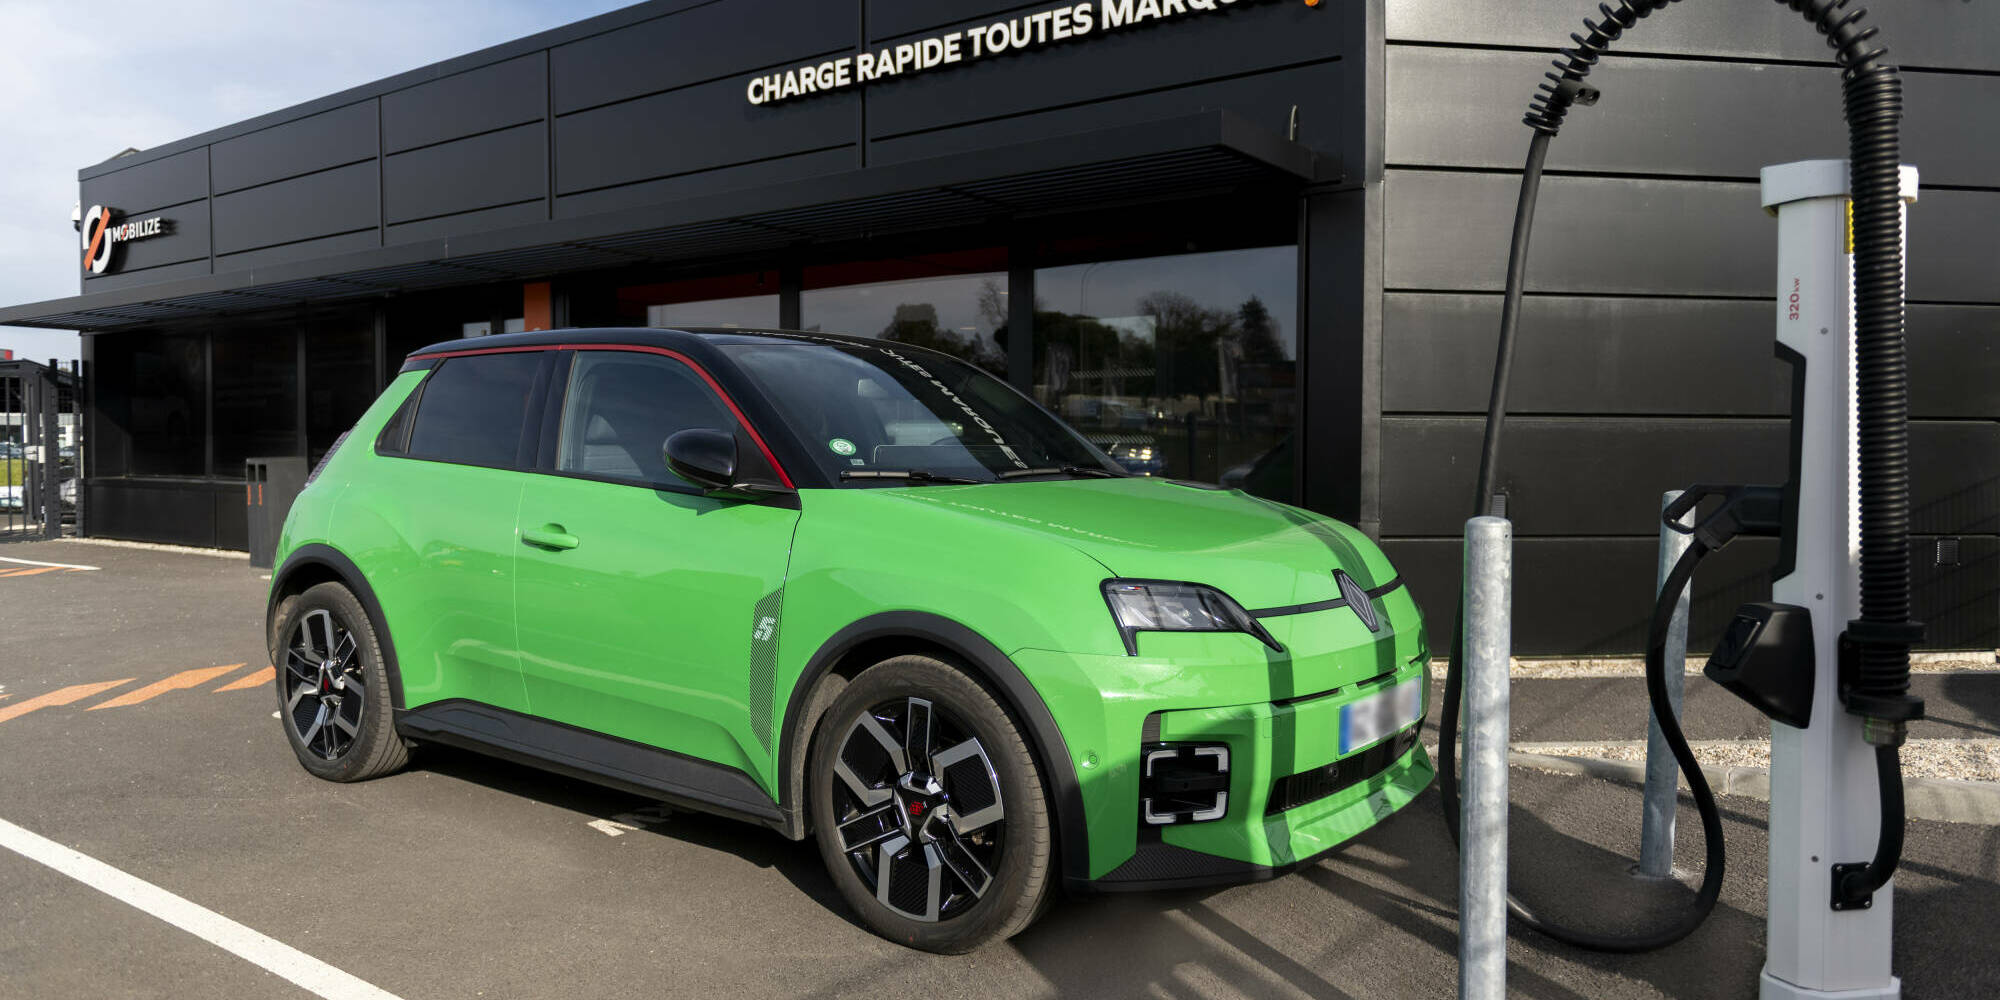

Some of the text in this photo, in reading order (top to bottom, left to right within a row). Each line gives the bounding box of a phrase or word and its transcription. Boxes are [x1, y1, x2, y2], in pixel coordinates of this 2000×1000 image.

[747, 58, 850, 104] CHARGE
[857, 32, 962, 81] RAPIDE
[967, 3, 1094, 56] TOUTES
[113, 217, 161, 242] MOBILIZE
